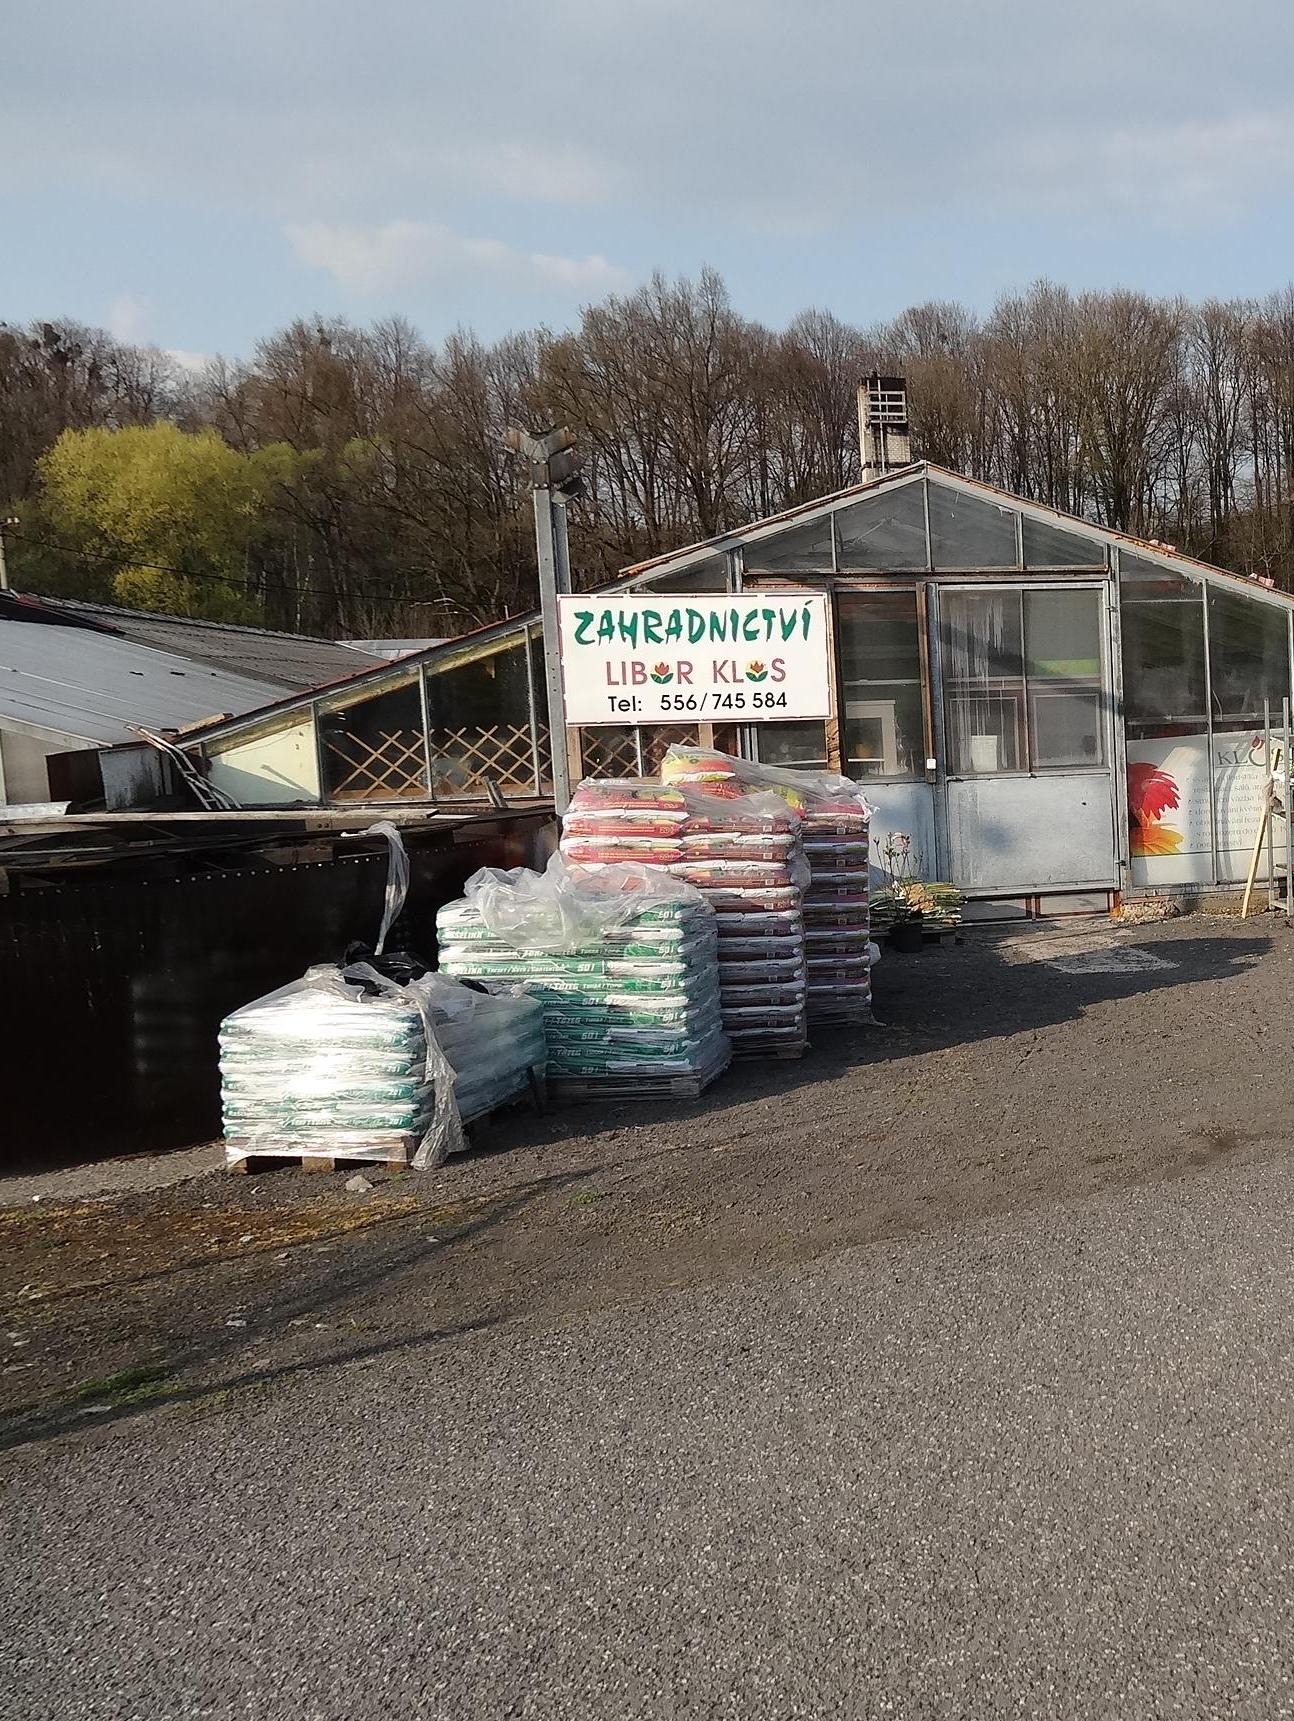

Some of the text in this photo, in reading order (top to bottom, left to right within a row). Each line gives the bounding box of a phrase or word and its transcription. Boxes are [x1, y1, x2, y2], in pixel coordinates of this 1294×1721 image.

[573, 600, 813, 650] ZAHRADNICTVÍ
[608, 695, 642, 712] Tel:
[752, 692, 788, 709] 584
